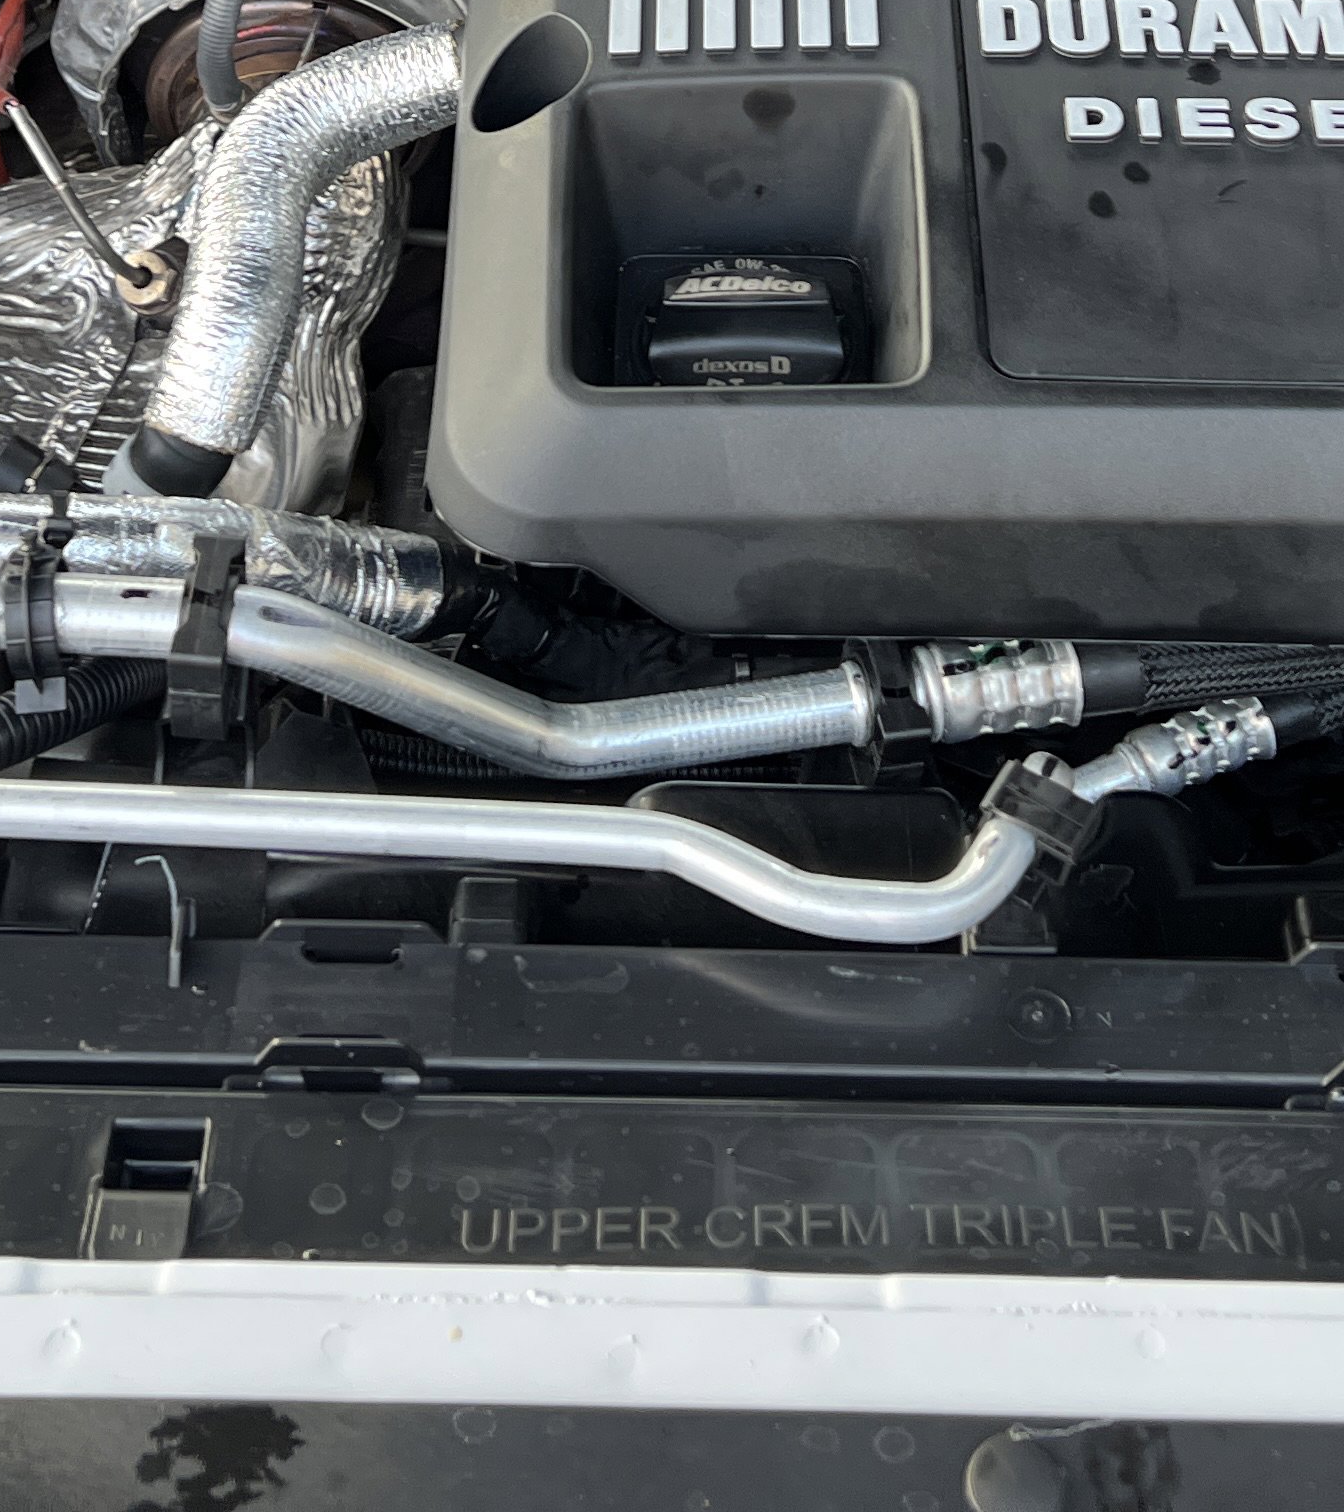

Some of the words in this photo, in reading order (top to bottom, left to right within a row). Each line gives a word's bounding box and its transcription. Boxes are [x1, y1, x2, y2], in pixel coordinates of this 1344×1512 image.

[673, 275, 812, 294] ACDelco
[459, 1205, 684, 1255] UPPER
[702, 1202, 892, 1250] CRFM
[911, 1201, 1144, 1251] TRIPLE
